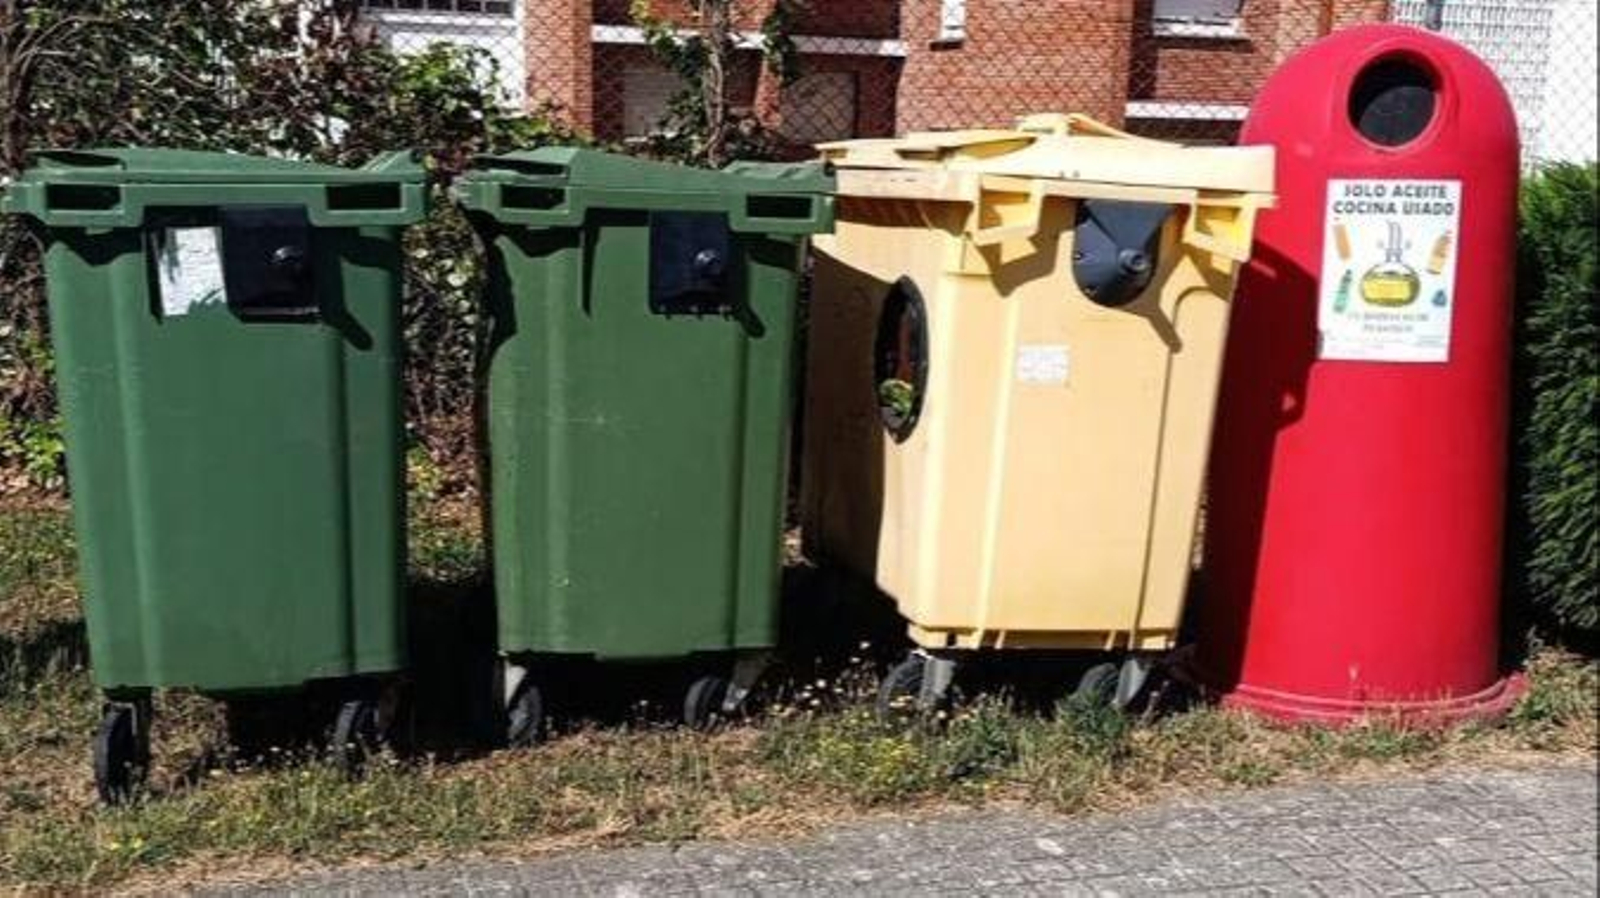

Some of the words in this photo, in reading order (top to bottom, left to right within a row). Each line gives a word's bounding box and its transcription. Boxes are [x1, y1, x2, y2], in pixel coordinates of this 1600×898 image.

[1344, 184, 1386, 197] SOLO
[1392, 184, 1447, 198] ACEITE
[1333, 200, 1397, 214] COCINA
[1402, 202, 1455, 215] USADO
